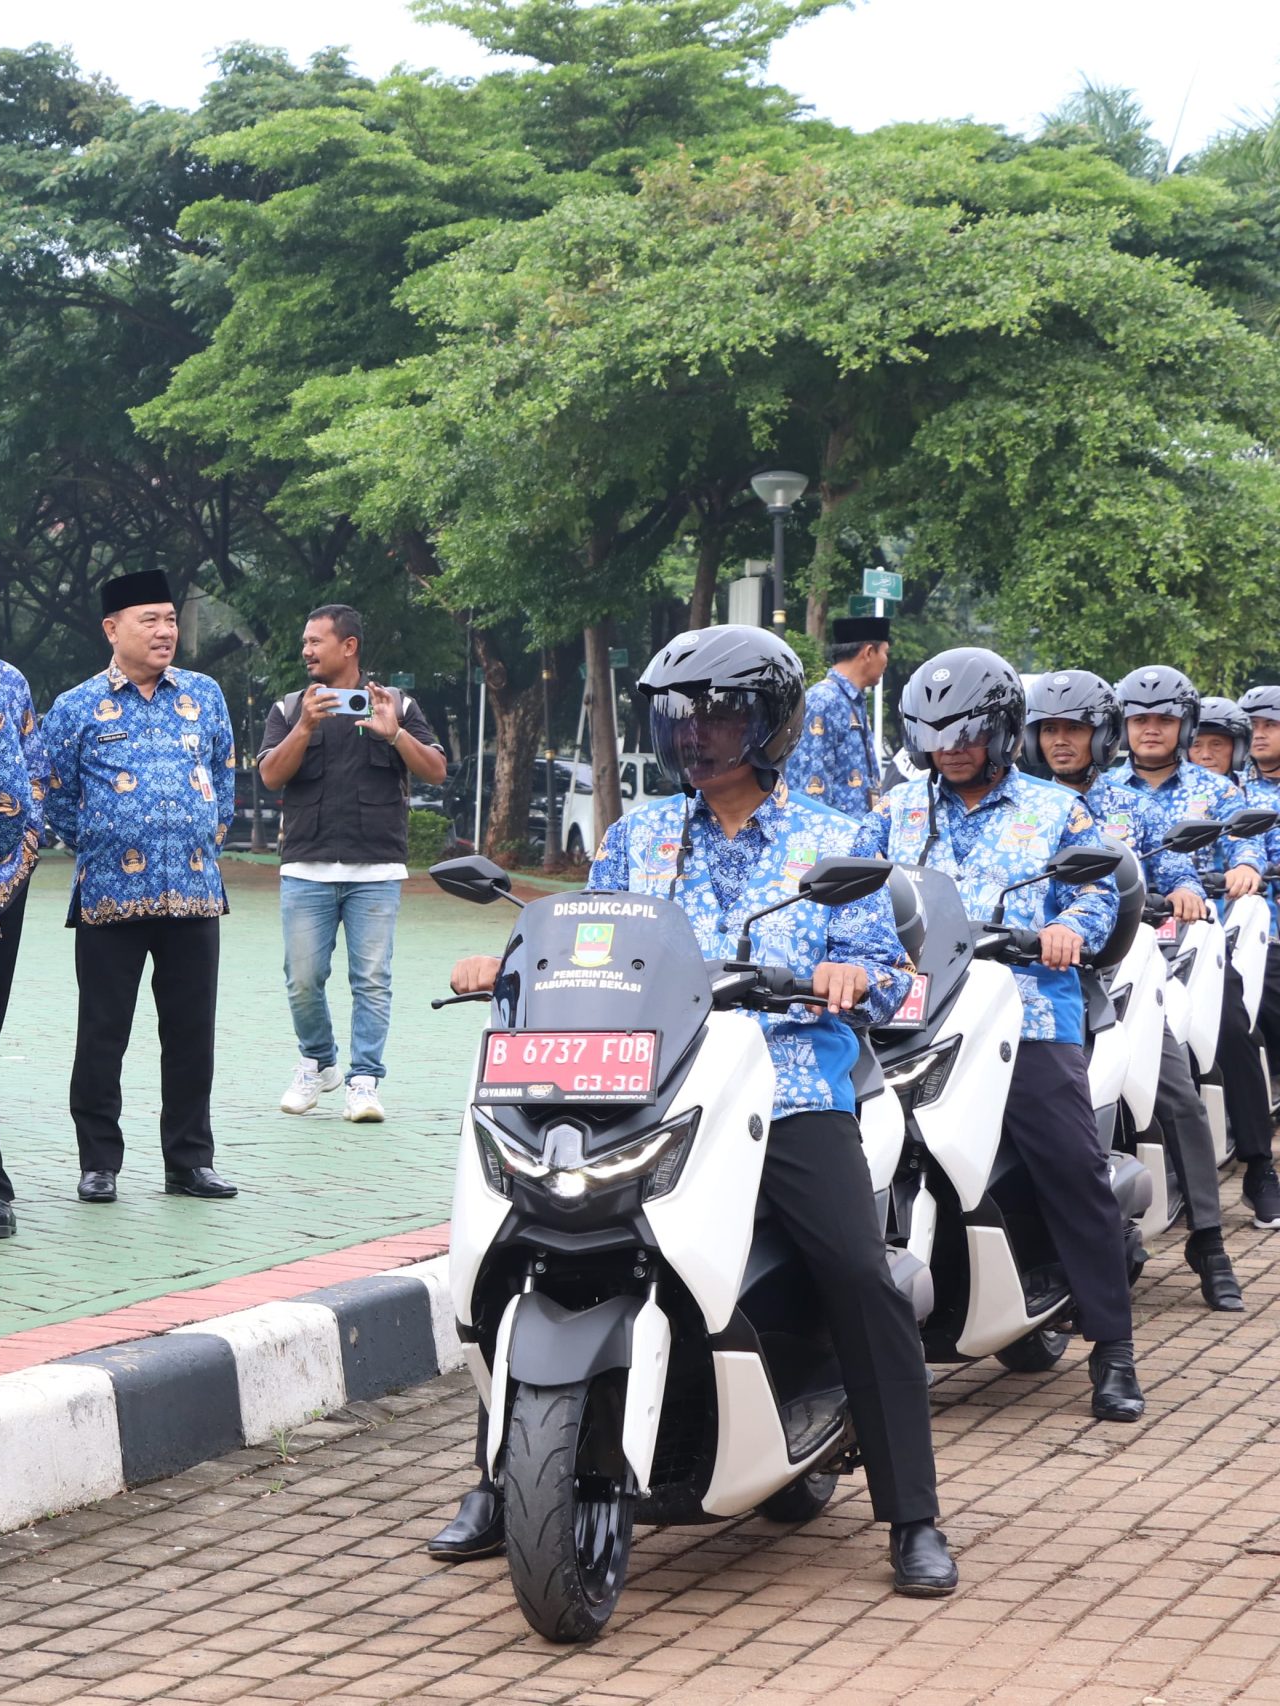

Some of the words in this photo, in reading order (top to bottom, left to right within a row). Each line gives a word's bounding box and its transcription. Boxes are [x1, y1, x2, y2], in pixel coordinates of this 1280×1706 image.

[553, 902, 658, 919] DISDUKCAPIL
[553, 970, 624, 980] PEMERINTAH
[534, 980, 597, 991] KABUPATEN
[599, 981, 642, 993] BEKASI
[492, 1039, 508, 1065] B
[522, 1038, 588, 1064] 6737
[488, 1087, 523, 1097] YAMAHA
